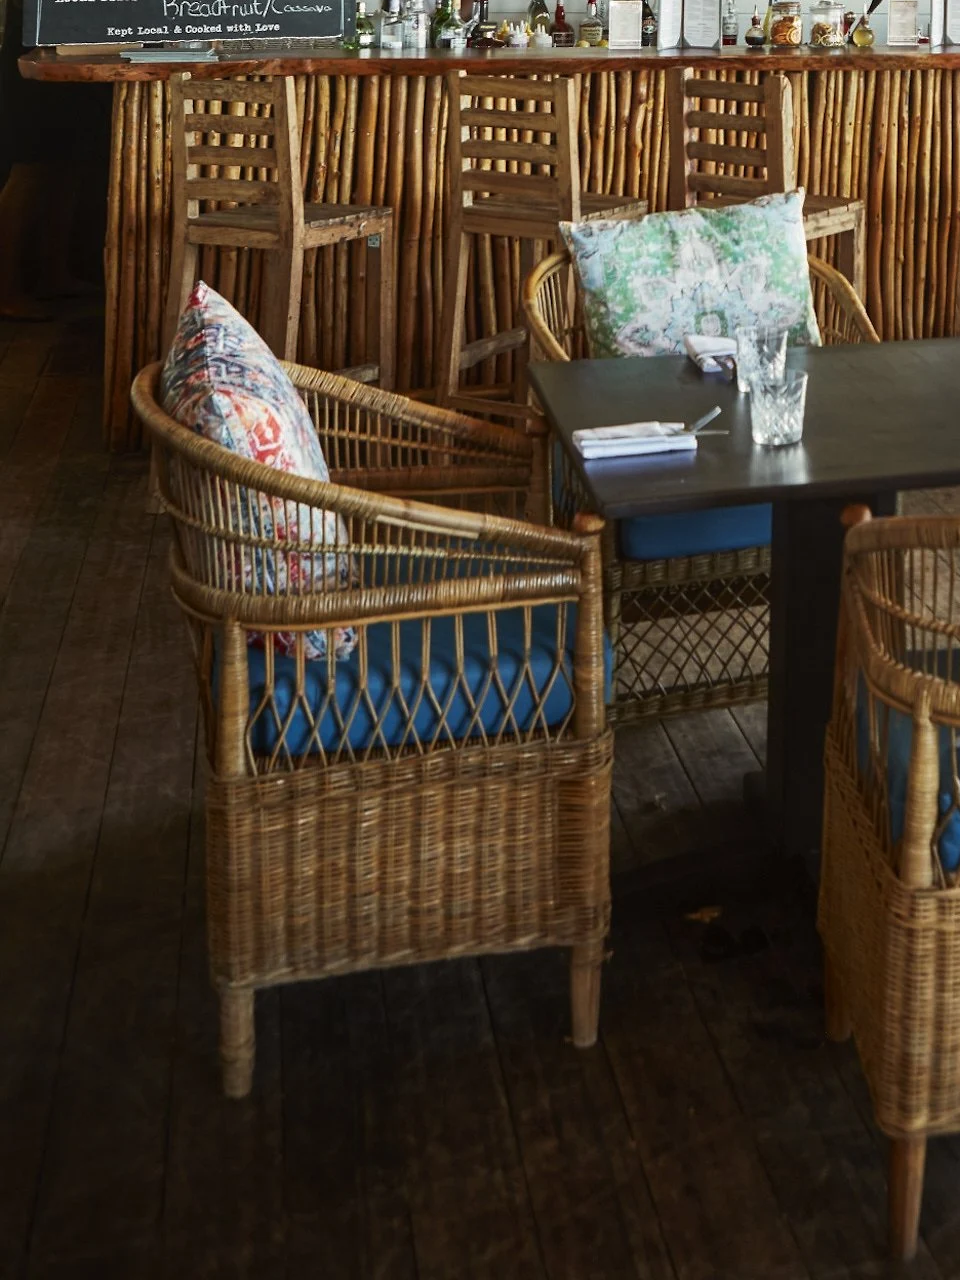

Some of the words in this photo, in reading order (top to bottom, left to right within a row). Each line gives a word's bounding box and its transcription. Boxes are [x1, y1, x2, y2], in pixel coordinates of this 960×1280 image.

[107, 27, 134, 37] Kept
[137, 25, 169, 35] Local
[173, 25, 182, 34] &
[185, 24, 222, 34] Cooked
[227, 23, 251, 33] with
[255, 22, 281, 32] Love
